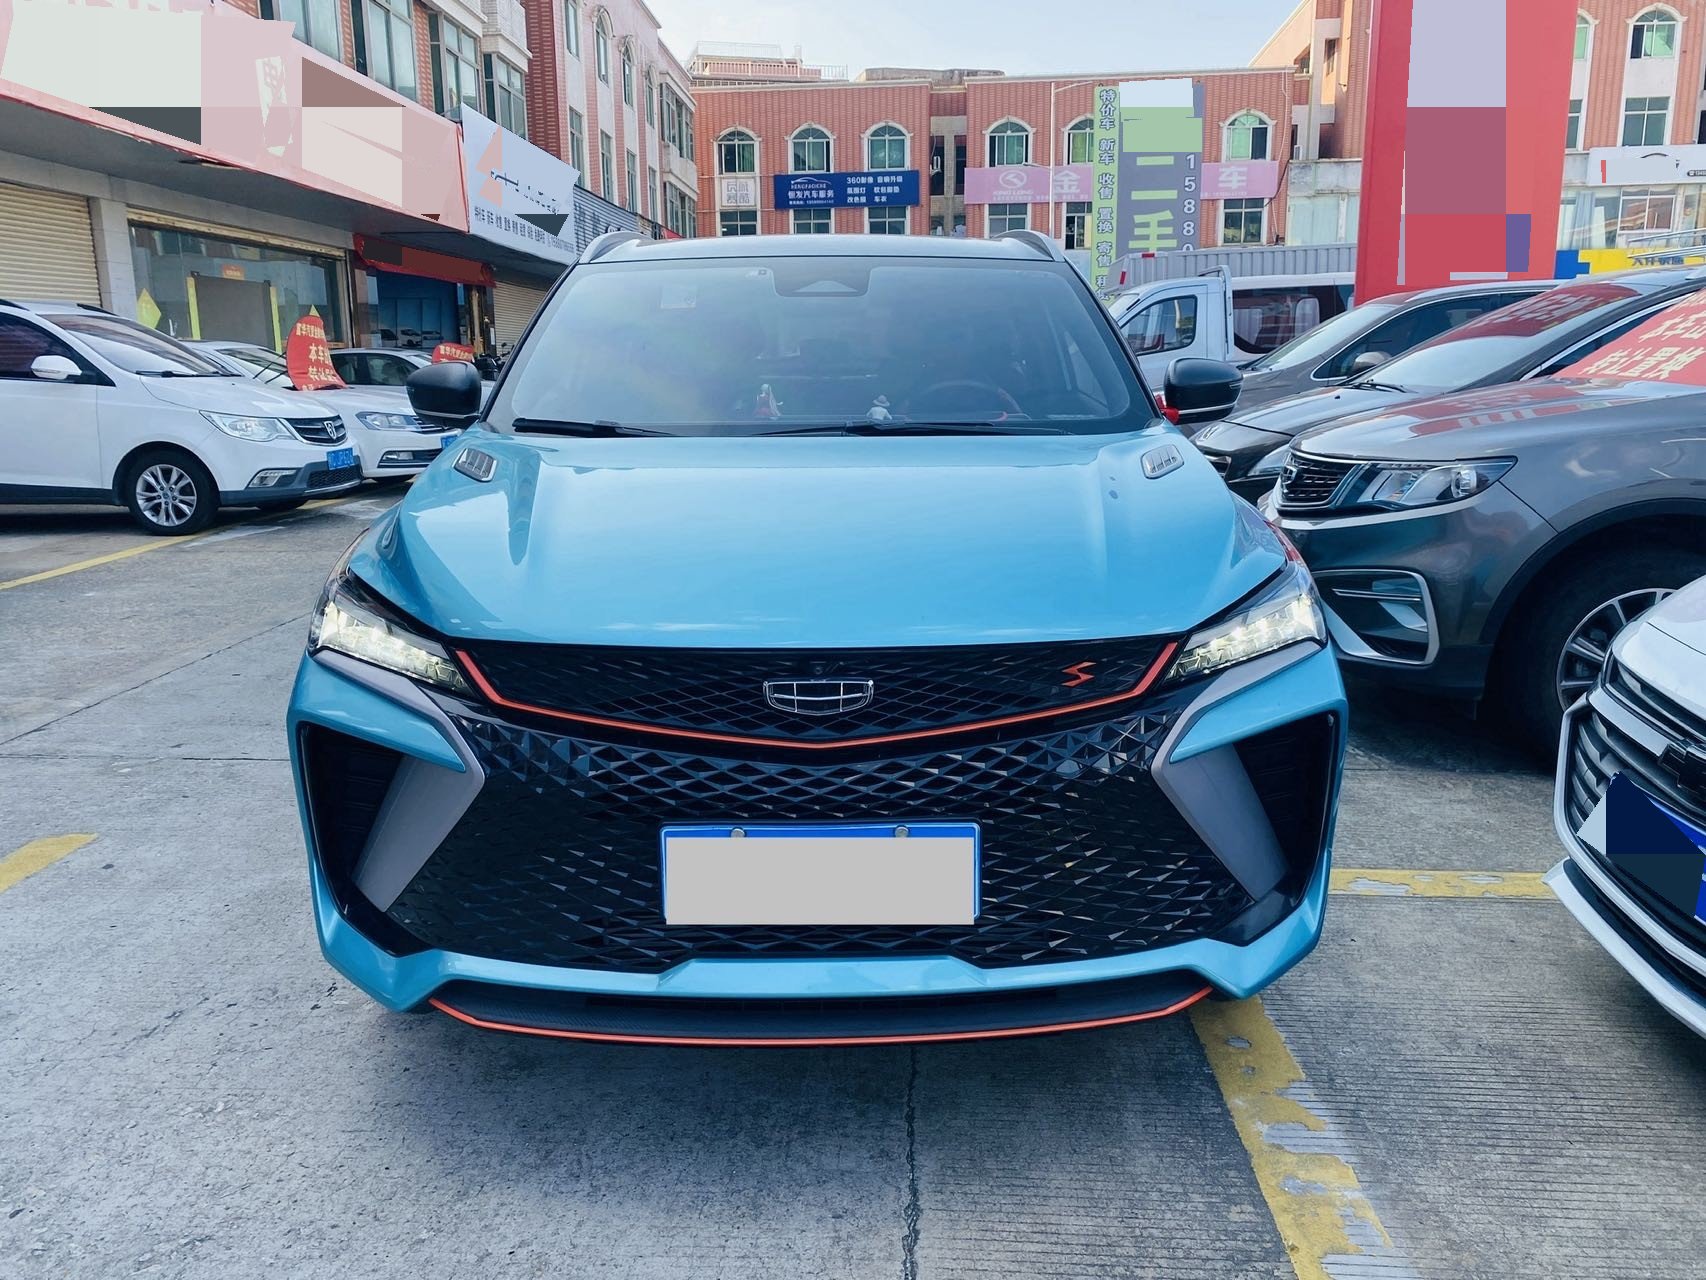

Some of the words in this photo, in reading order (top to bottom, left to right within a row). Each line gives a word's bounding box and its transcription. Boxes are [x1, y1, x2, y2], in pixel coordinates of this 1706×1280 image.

[1099, 89, 1116, 130] 特价车
[1099, 138, 1115, 165] 新车
[1054, 170, 1081, 193] 金
[1217, 166, 1248, 189] 车
[1098, 173, 1114, 200] 收售
[788, 190, 835, 199] 恒发汽车服务
[1097, 207, 1114, 234] 置换
[1096, 241, 1113, 268] 寄售
[1061, 661, 1096, 687] S
